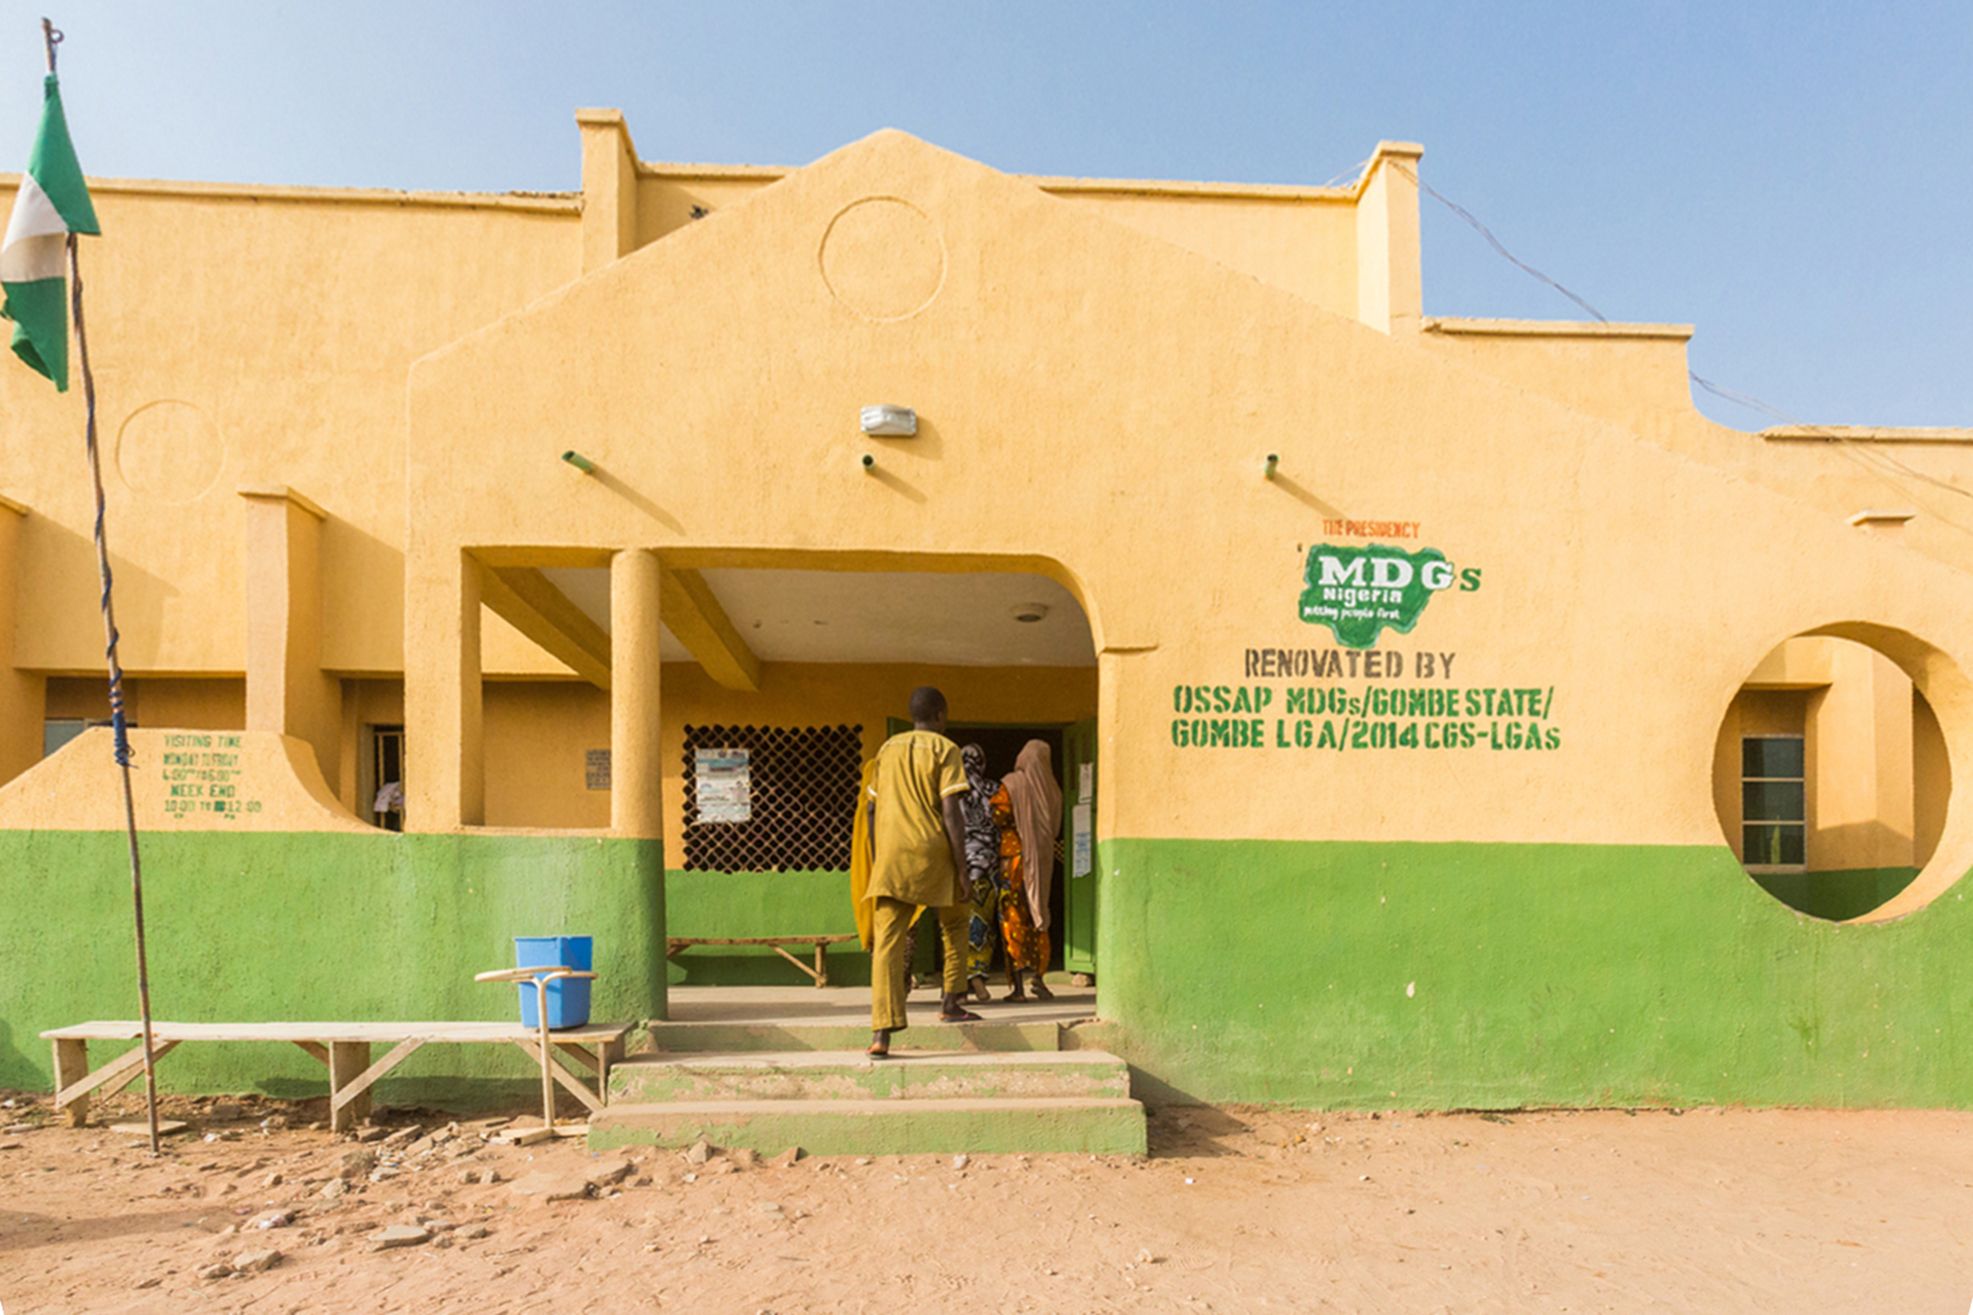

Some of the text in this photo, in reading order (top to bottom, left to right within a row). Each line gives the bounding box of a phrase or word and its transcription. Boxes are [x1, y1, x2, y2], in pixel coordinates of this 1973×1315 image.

[1322, 519, 1421, 539] THE PRESIDENCY
[1323, 587, 1403, 608] Nigeria
[1341, 607, 1374, 621] people
[1245, 648, 1456, 679] RENOVATED BY
[1173, 685, 1273, 714] OSSAP
[164, 734, 242, 748] VISITING TIME
[1171, 719, 1265, 748] GOMBE
[209, 783, 236, 798] END
